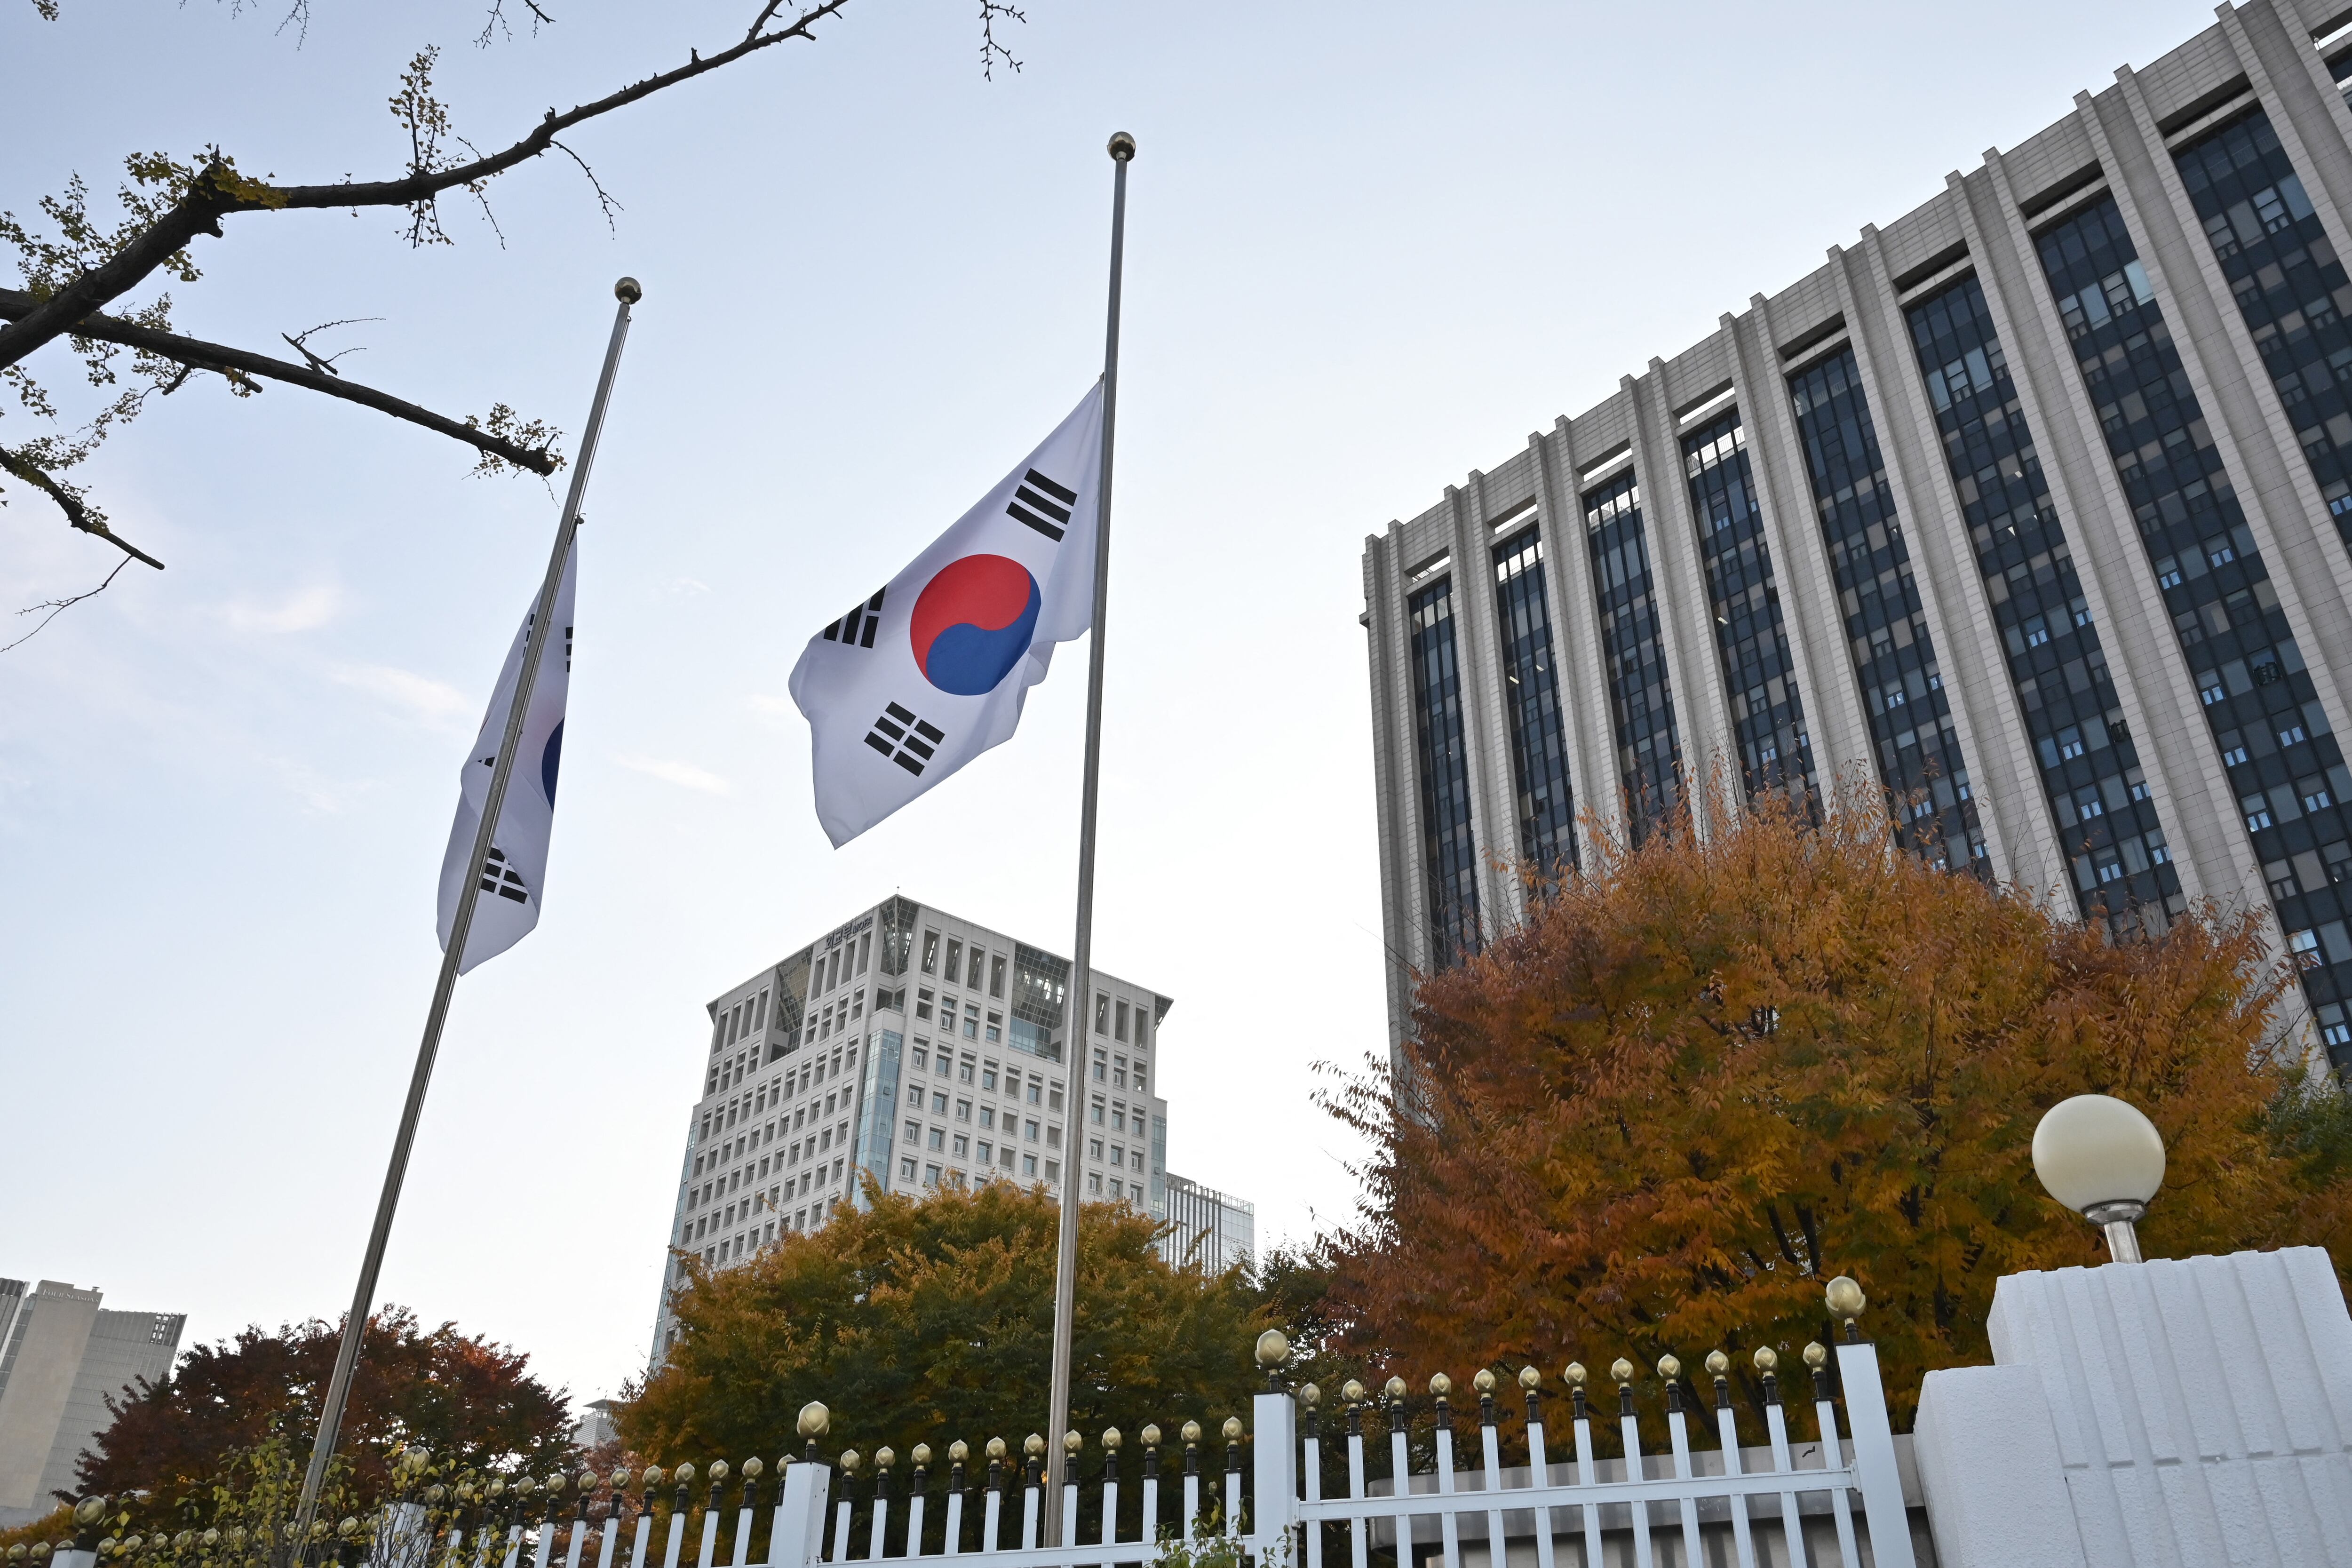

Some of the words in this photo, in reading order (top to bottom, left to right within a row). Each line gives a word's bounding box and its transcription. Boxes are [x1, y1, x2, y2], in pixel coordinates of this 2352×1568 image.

[824, 923, 852, 950] 외교부
[852, 916, 872, 934] MOFA
[42, 1289, 64, 1297] FOUR
